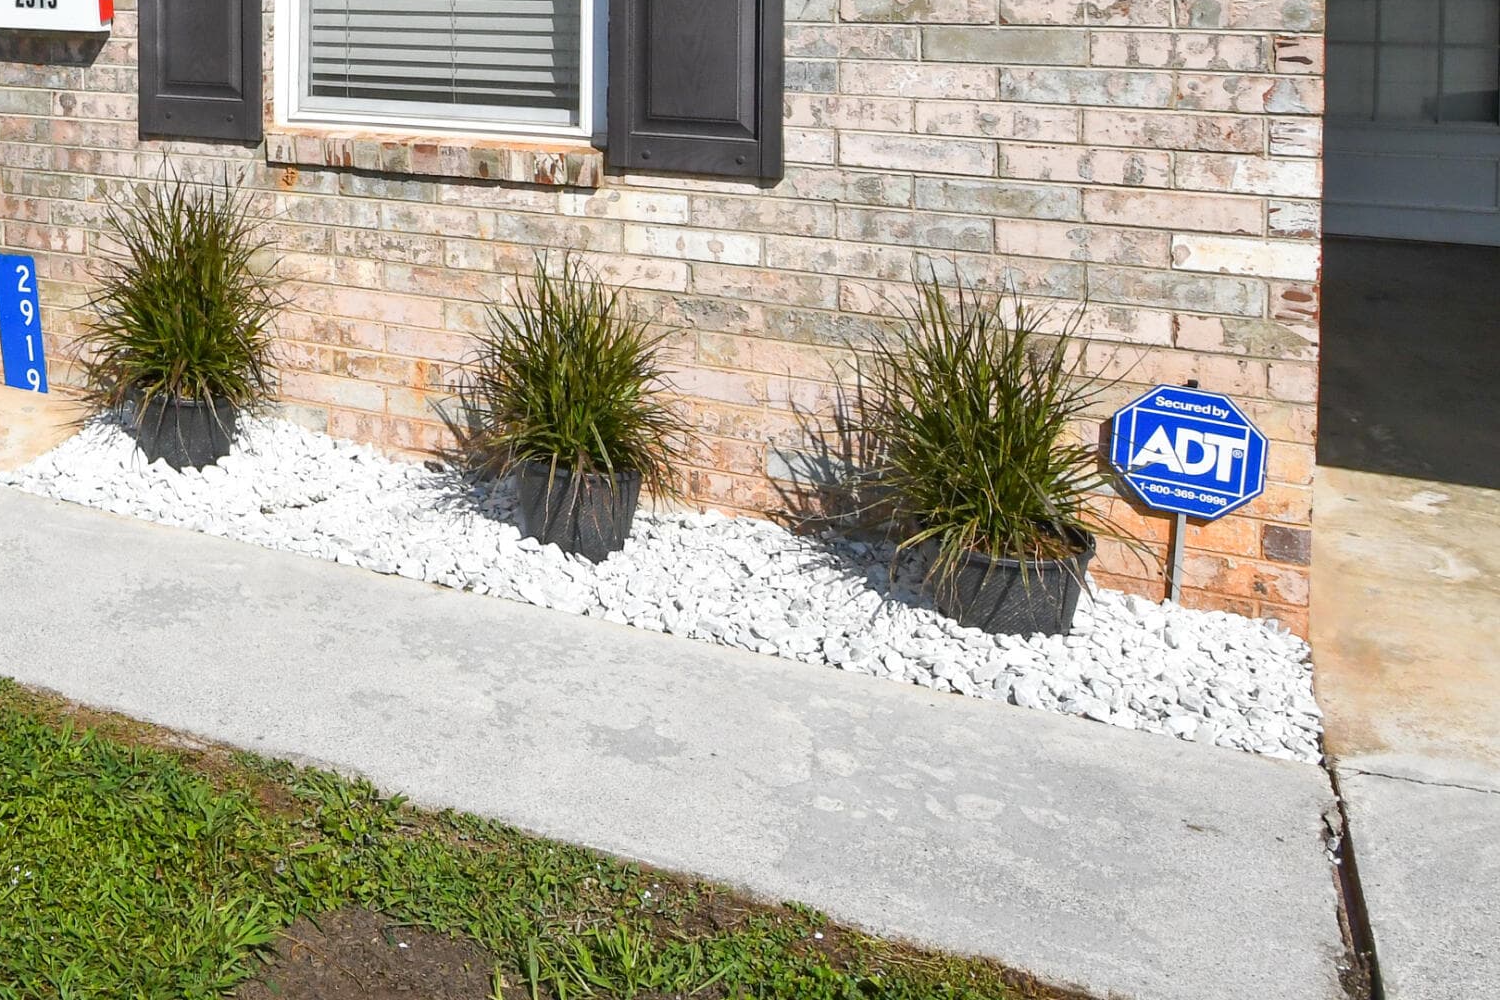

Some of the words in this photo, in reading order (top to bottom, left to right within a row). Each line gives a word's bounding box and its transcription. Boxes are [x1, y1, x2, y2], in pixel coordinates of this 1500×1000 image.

[16, 264, 41, 393] 2919
[1155, 395, 1211, 415] Secured
[1212, 405, 1230, 420] by
[1131, 424, 1247, 483] ADT
